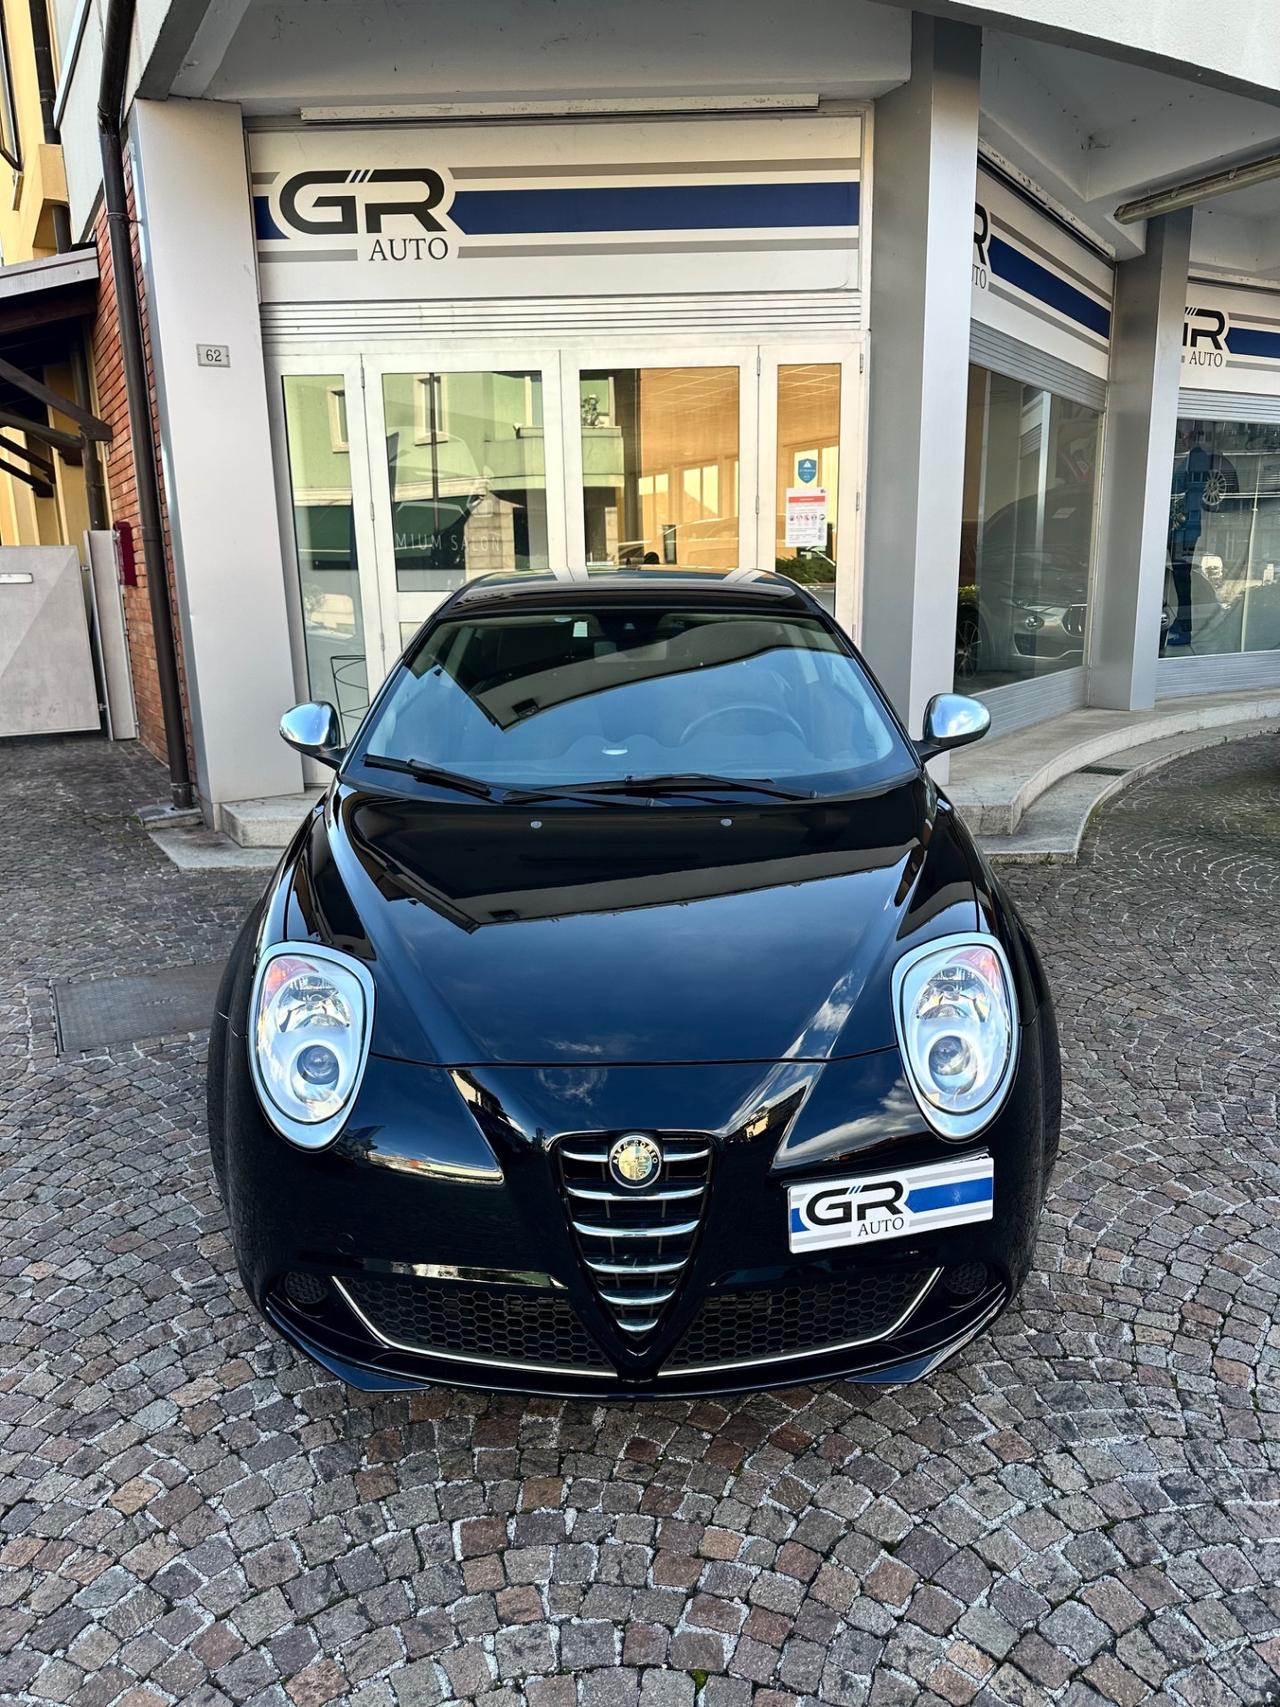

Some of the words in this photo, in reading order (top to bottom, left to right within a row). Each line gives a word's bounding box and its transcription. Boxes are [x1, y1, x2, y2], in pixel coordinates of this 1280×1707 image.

[279, 168, 447, 235] GR
[368, 237, 449, 262] AUTO
[206, 349, 222, 362] 62
[1189, 350, 1223, 367] AUTO
[451, 535, 500, 552] SALON
[806, 1180, 904, 1226] GR
[858, 1217, 904, 1237] AUTO
